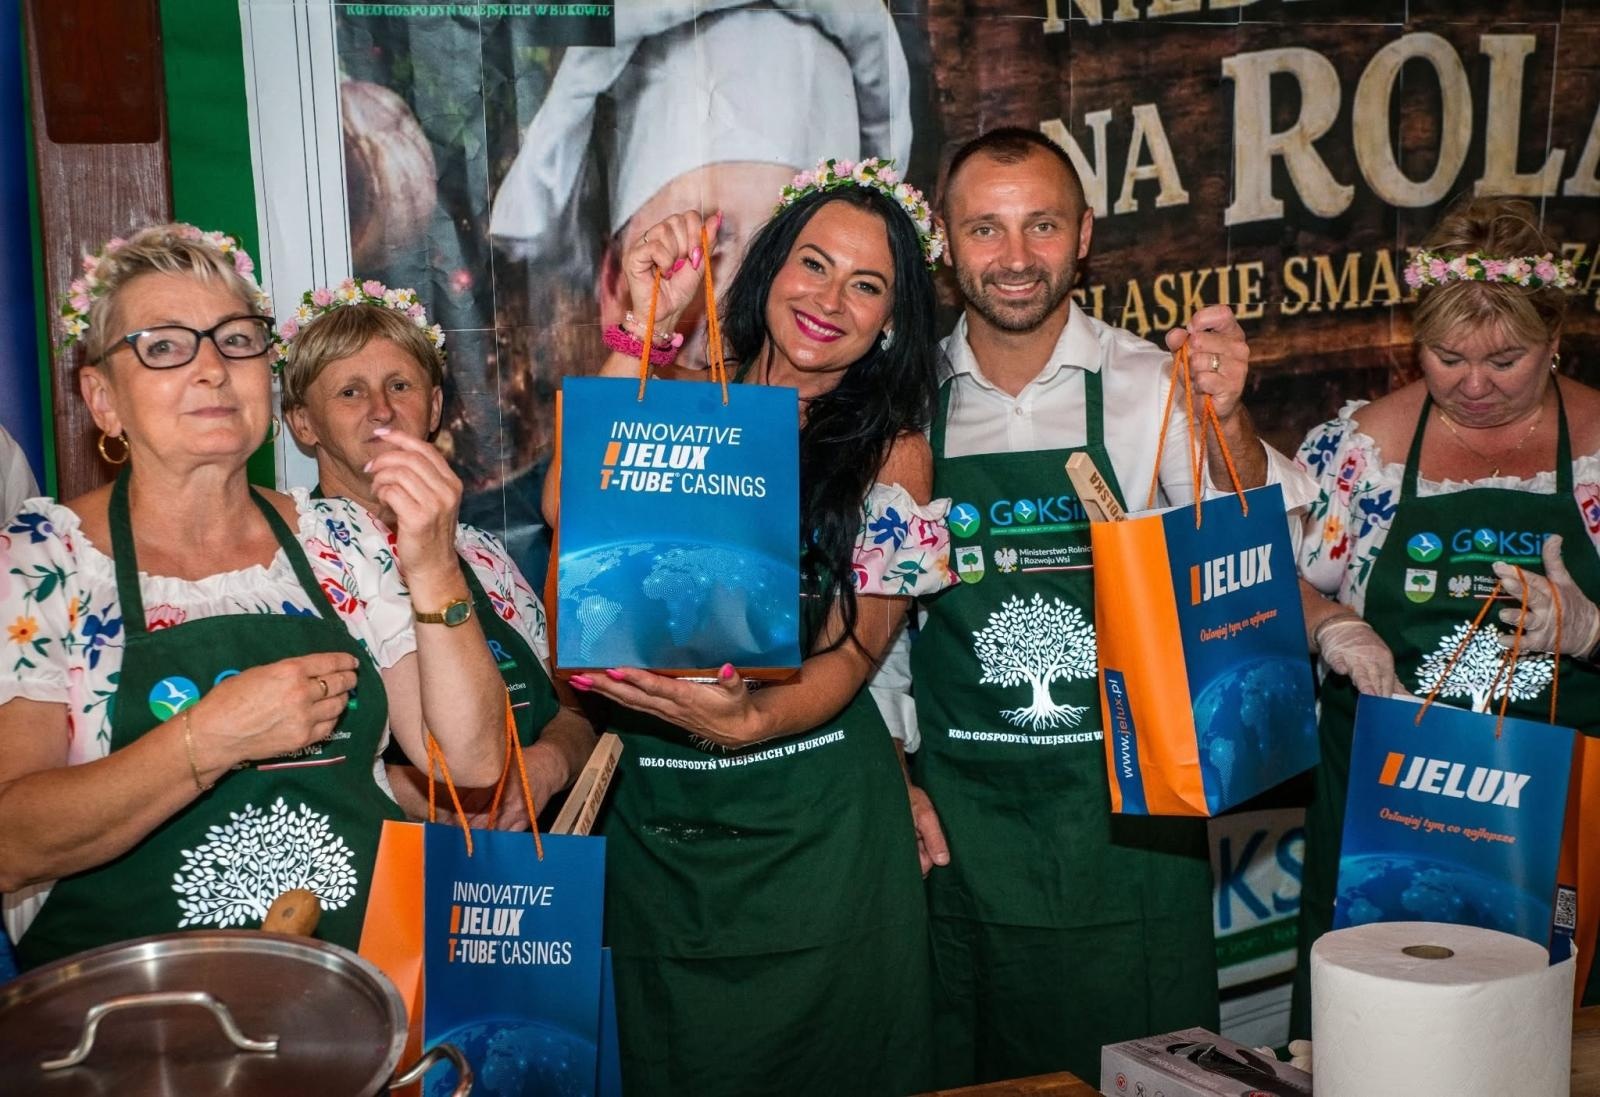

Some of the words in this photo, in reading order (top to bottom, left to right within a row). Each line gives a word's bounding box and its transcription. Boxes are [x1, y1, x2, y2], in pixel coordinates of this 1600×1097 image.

[459, 4, 531, 17] WIEJSKICH
[534, 5, 547, 15] W
[549, 4, 610, 16] BUKOWIE
[1040, 103, 1190, 218] NA
[1222, 31, 1600, 227] ROL
[610, 421, 743, 446] INNOVATIVE
[620, 442, 710, 470] JELUX
[681, 472, 767, 498] CASINGS
[1019, 547, 1068, 557] Ministerstwo
[1024, 556, 1056, 566] Rozwoju
[1056, 555, 1071, 564] Wsi
[1203, 543, 1273, 602] JELUX
[972, 731, 1029, 744] GOSPODYŃ
[1029, 731, 1093, 746] WIEJSKICH
[1108, 679, 1134, 778] www.jelux.pl
[639, 756, 665, 768] KOŁO
[666, 758, 717, 770] GOSPODYŃ
[718, 748, 784, 769] WIEJSKICH
[784, 744, 796, 756] W
[798, 729, 846, 752] BUKOWIE
[1400, 755, 1532, 809] JELUX
[453, 881, 555, 906] INNOVATIVE
[460, 906, 525, 936] JELUX
[501, 940, 572, 965] CASINGS
